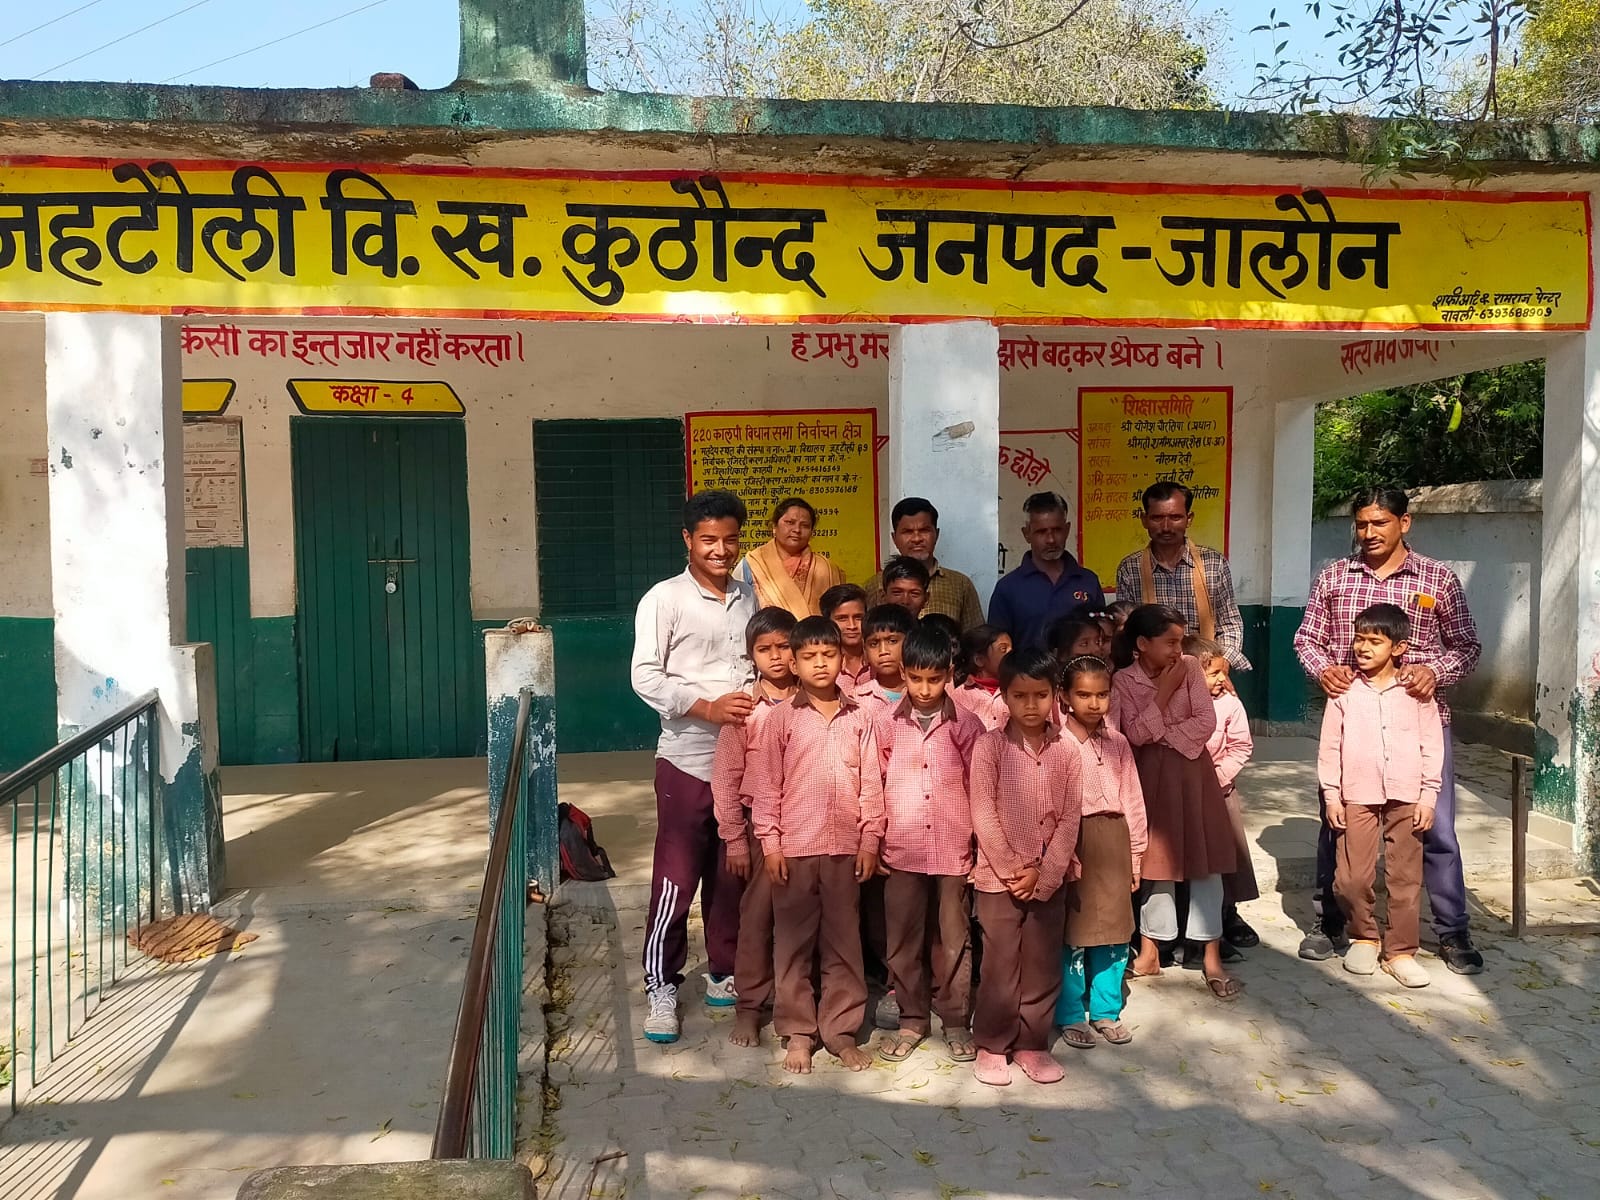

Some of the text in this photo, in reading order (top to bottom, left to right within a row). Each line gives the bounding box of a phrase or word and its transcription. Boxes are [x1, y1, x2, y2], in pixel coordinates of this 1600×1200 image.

[562, 174, 827, 306] कुठौन्द
[1494, 293, 1533, 305] रामराज
[247, 329, 289, 357] का
[812, 333, 858, 368] प्रभु
[1042, 341, 1107, 373] बढ़कर
[1109, 335, 1163, 368] श्रेष्ठ
[1167, 336, 1205, 370] बने
[329, 385, 380, 408] कक्षा
[401, 387, 414, 406] 4
[693, 429, 711, 442] 220
[713, 424, 742, 444] कालपी
[796, 419, 837, 440] निर्वाचन
[842, 420, 862, 441] क्षेत्र
